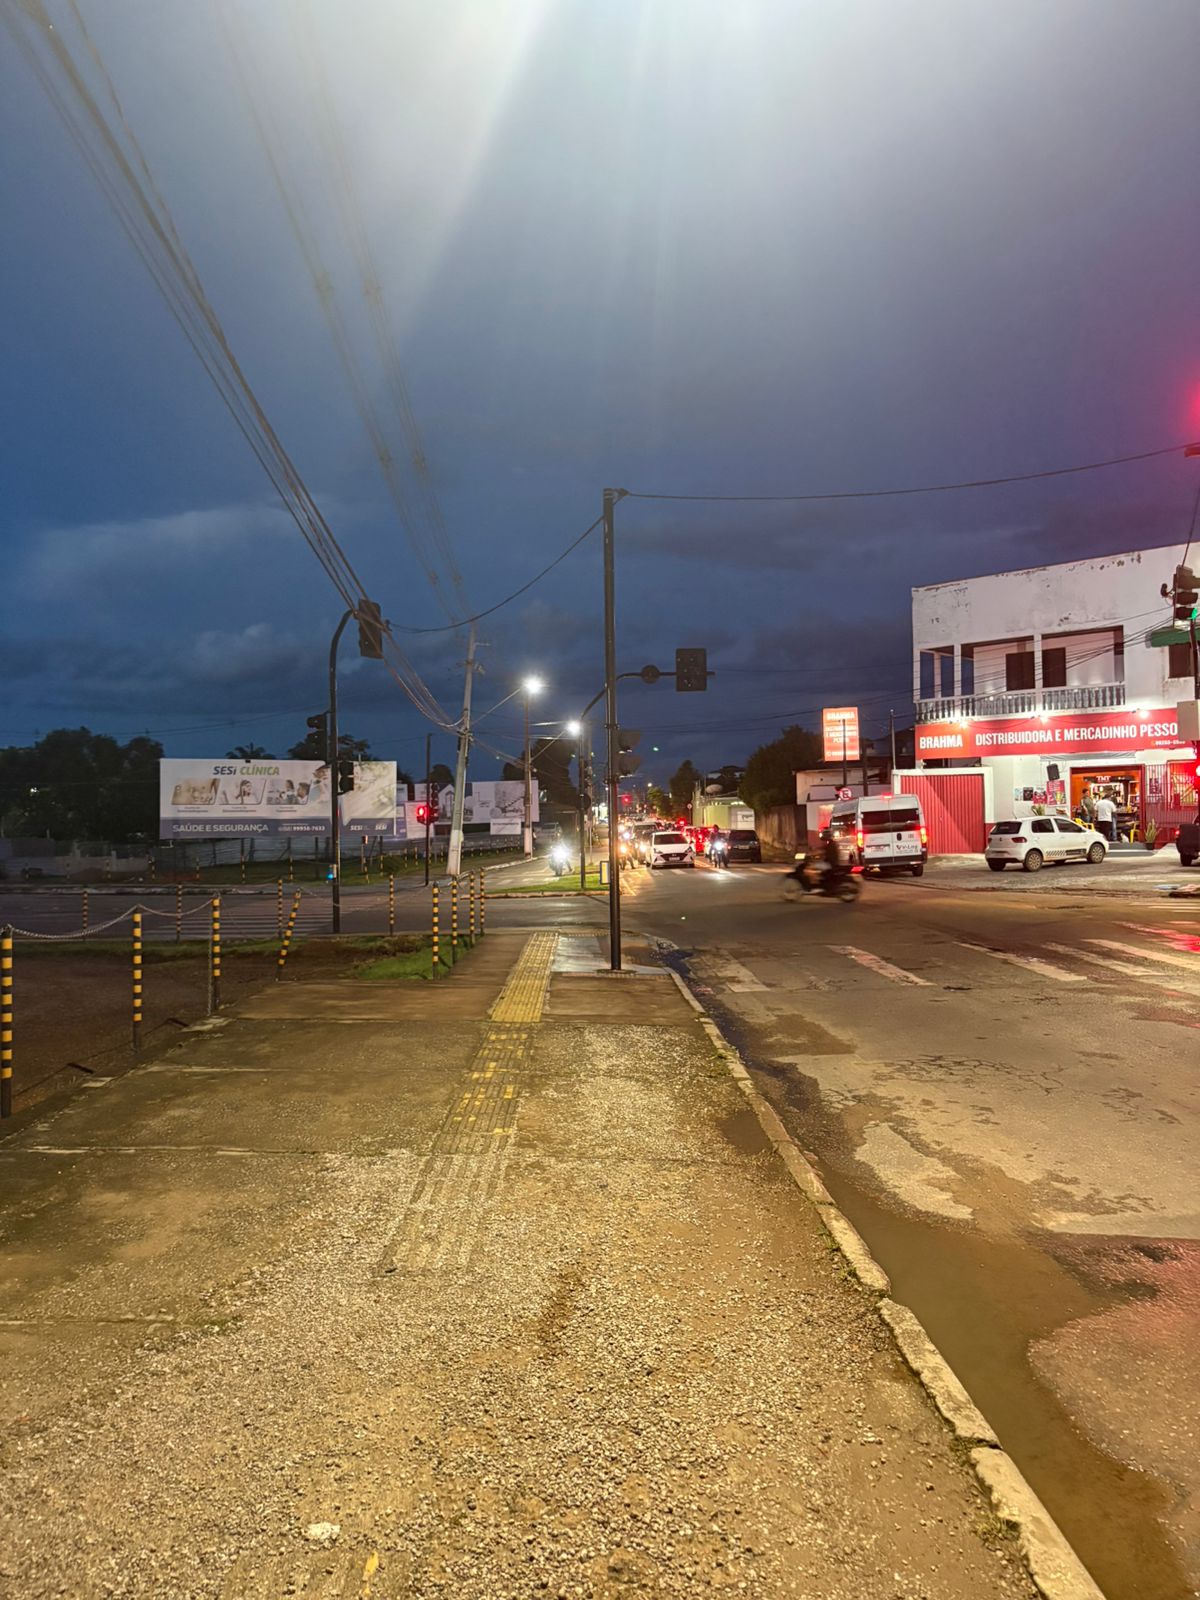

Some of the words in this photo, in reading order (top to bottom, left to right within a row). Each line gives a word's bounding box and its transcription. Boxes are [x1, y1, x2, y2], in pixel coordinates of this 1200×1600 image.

[975, 729, 1053, 746] DISTRIBUIDORA
[1055, 729, 1062, 742] E
[1063, 725, 1137, 741] MERCADINHO
[1139, 722, 1178, 737] PESSO
[919, 734, 963, 749] BRAHMA
[239, 765, 280, 776] CLÍNICA
[172, 823, 205, 832] SAÚDE
[206, 824, 212, 832] E
[212, 823, 269, 833] SEGURANÇA
